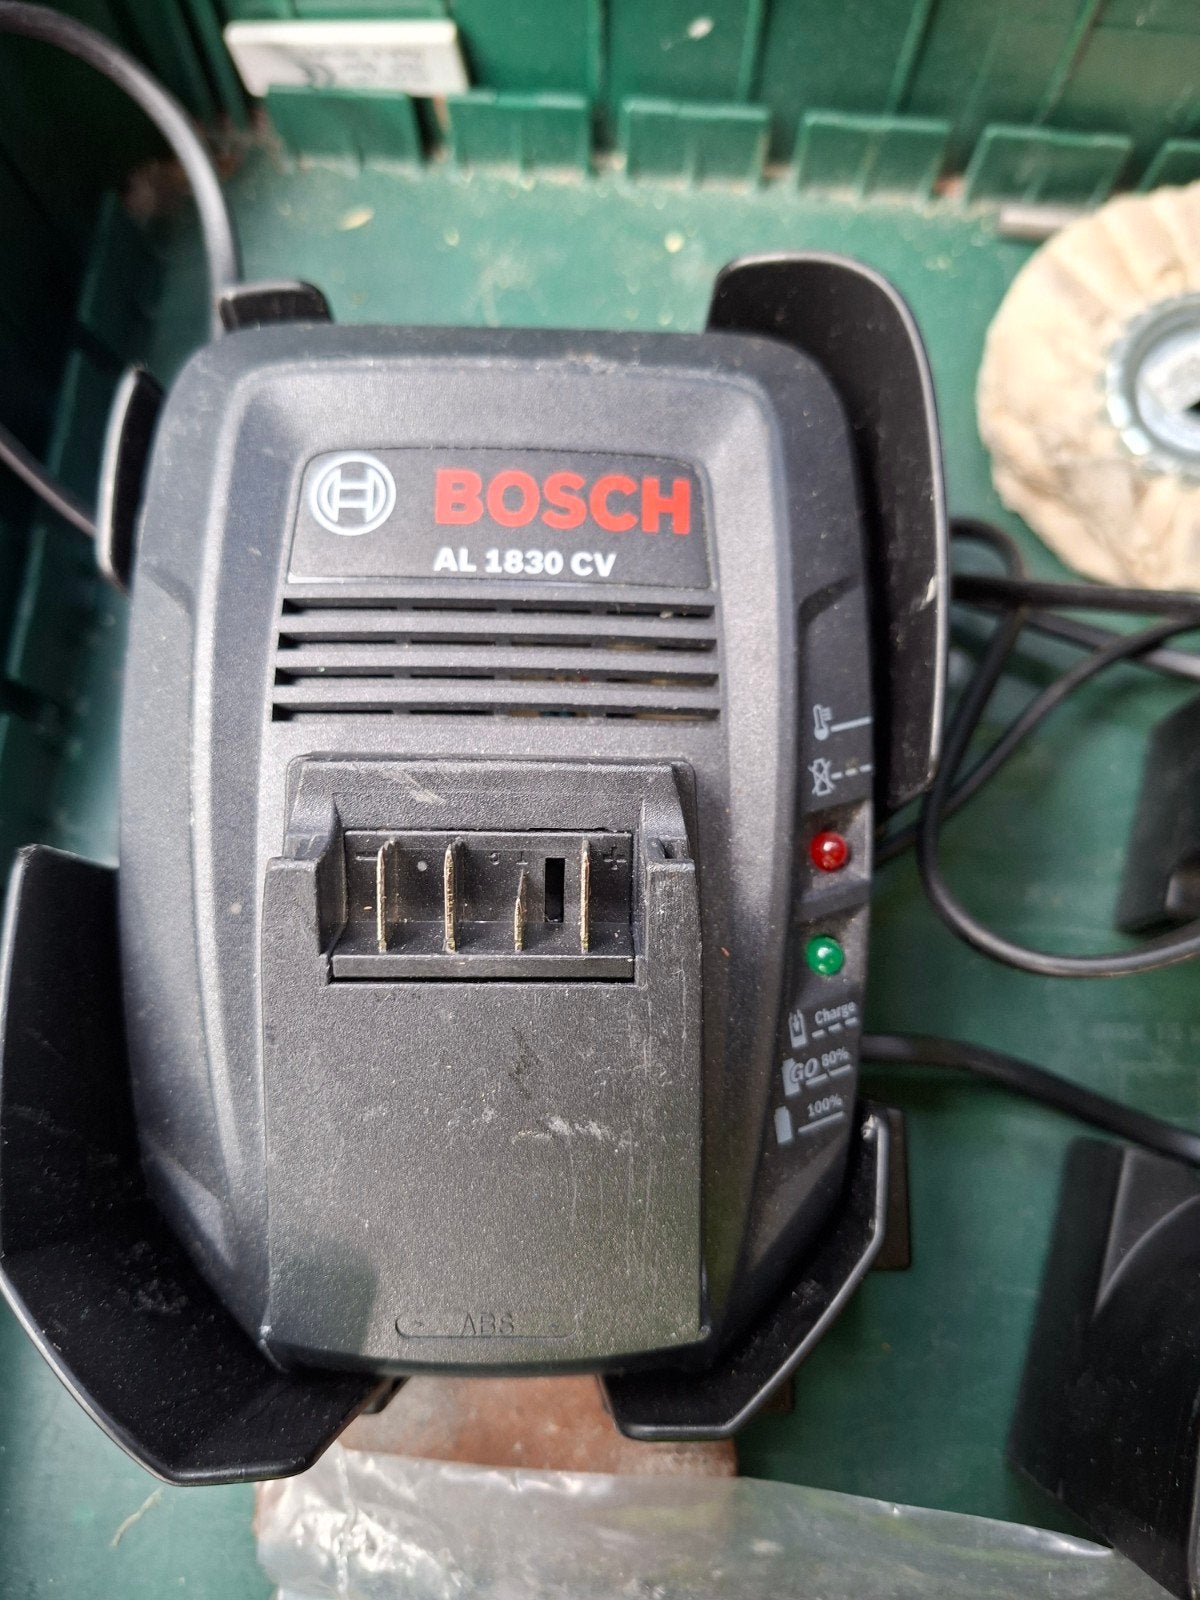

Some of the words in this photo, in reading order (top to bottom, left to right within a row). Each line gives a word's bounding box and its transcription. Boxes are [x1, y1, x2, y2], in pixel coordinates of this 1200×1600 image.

[434, 468, 691, 535] BOSCH
[433, 547, 477, 572] AL
[485, 549, 564, 575] 1830
[569, 552, 617, 577] CV
[815, 1002, 857, 1025] Charge
[807, 1094, 843, 1117] 100%
